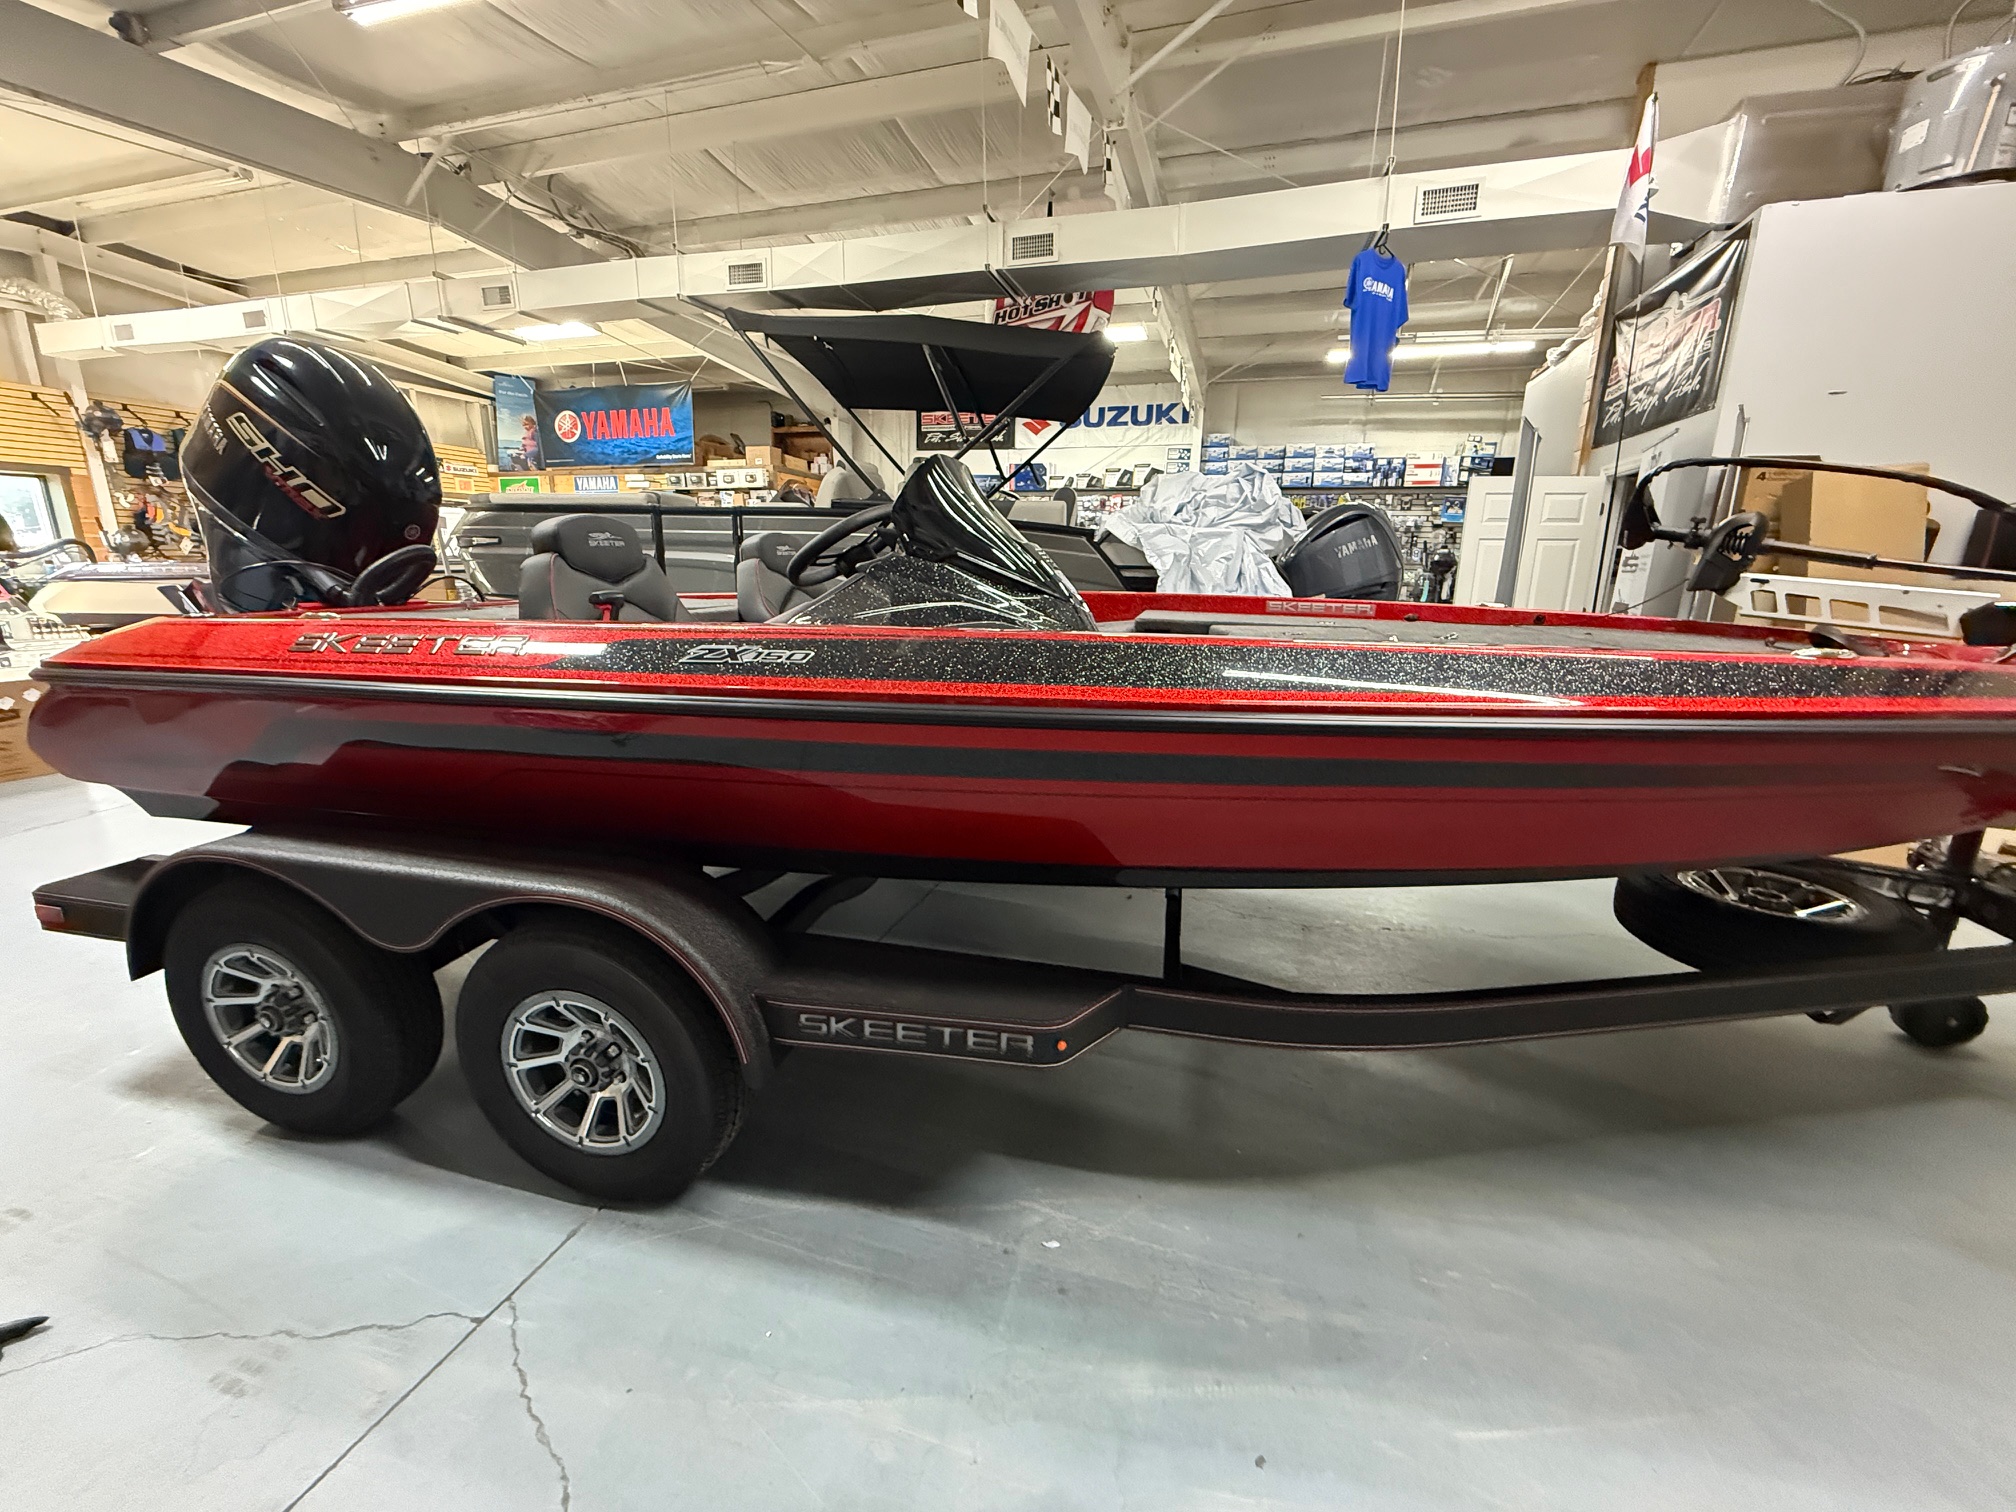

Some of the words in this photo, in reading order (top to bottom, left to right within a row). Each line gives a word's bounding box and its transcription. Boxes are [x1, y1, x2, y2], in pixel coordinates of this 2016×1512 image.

[581, 406, 676, 440] YAMAHA
[921, 412, 998, 425] SKEETE
[576, 476, 617, 490] YAMAHA
[1334, 534, 1379, 558] YAMAHA
[1266, 601, 1374, 616] SKEETER
[287, 632, 531, 656] SKEETER
[799, 1013, 1035, 1058] SKEETER
